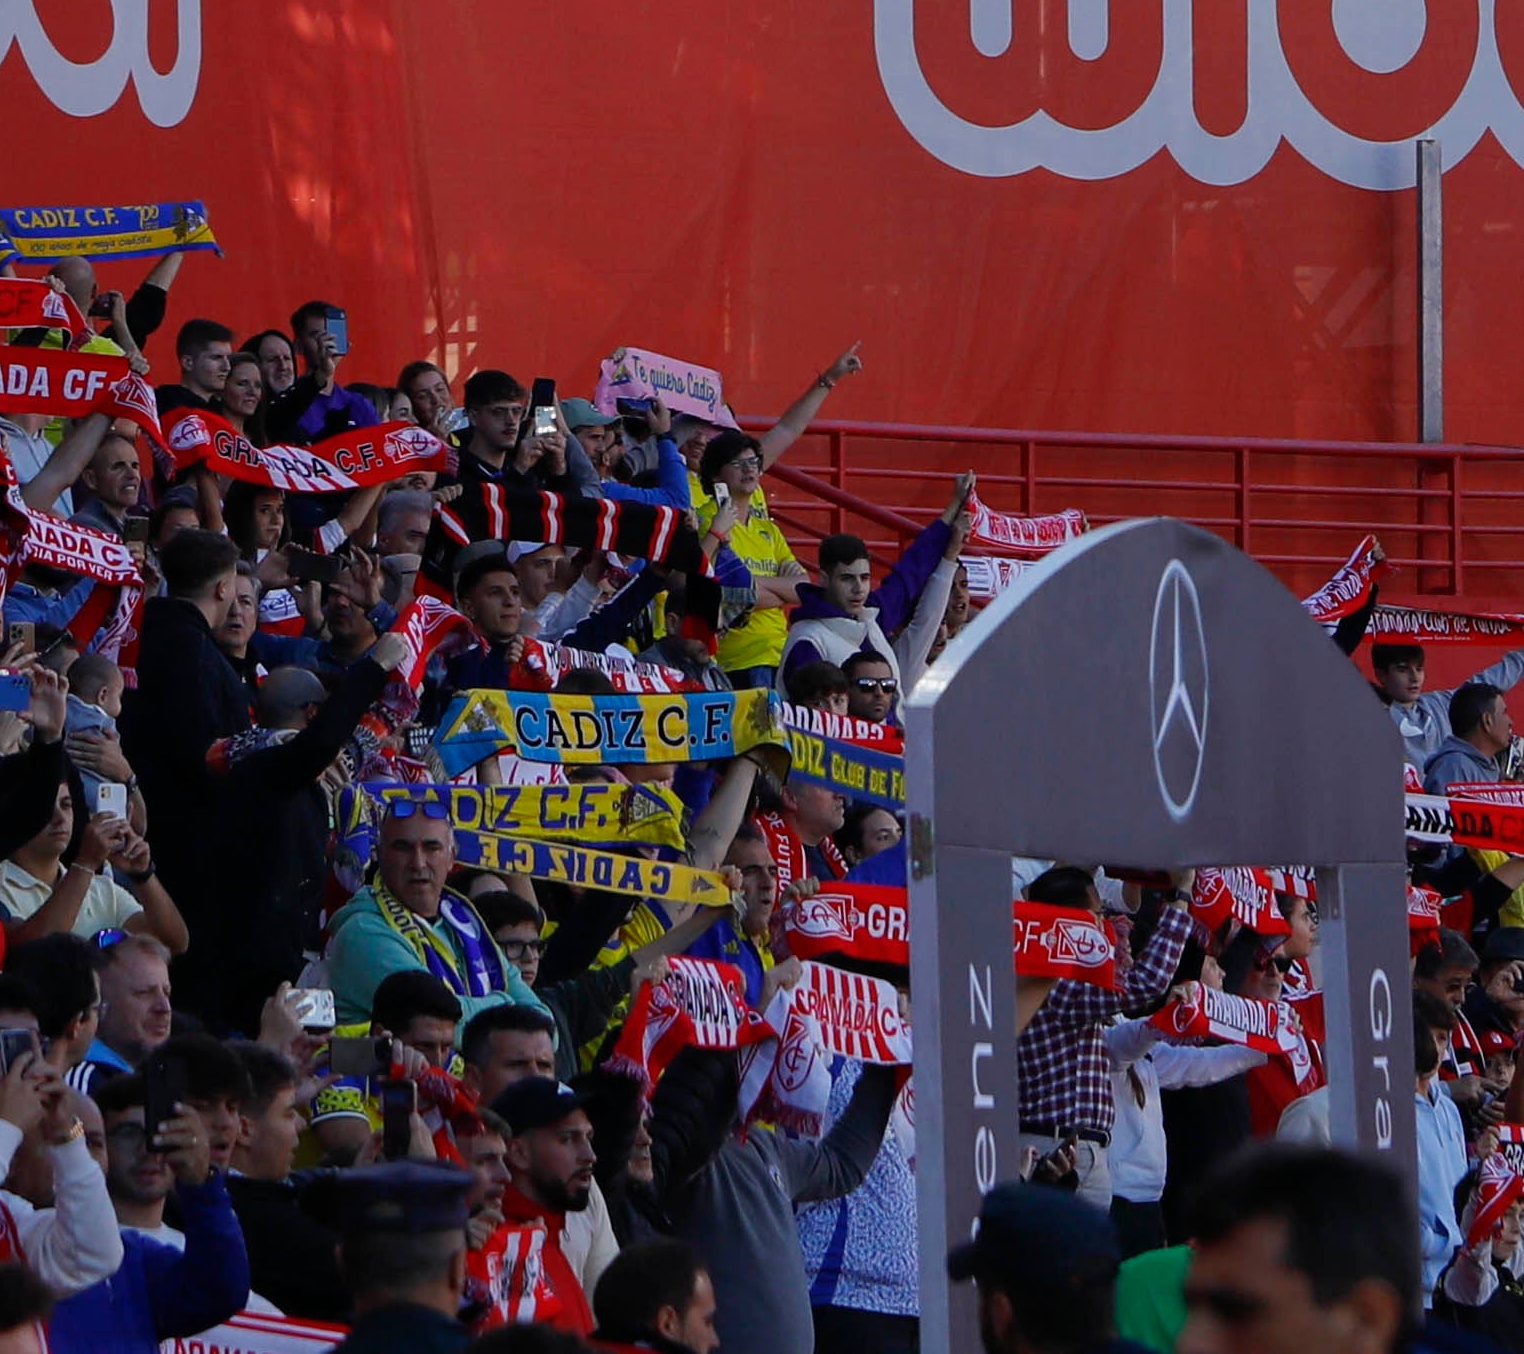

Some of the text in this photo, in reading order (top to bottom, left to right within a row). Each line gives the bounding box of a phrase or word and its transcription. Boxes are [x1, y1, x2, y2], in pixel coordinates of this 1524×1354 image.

[62, 366, 106, 400] CF
[514, 699, 732, 750] CADIZ C.F.
[830, 756, 887, 792] CLUB DE
[538, 783, 608, 827] C.F.
